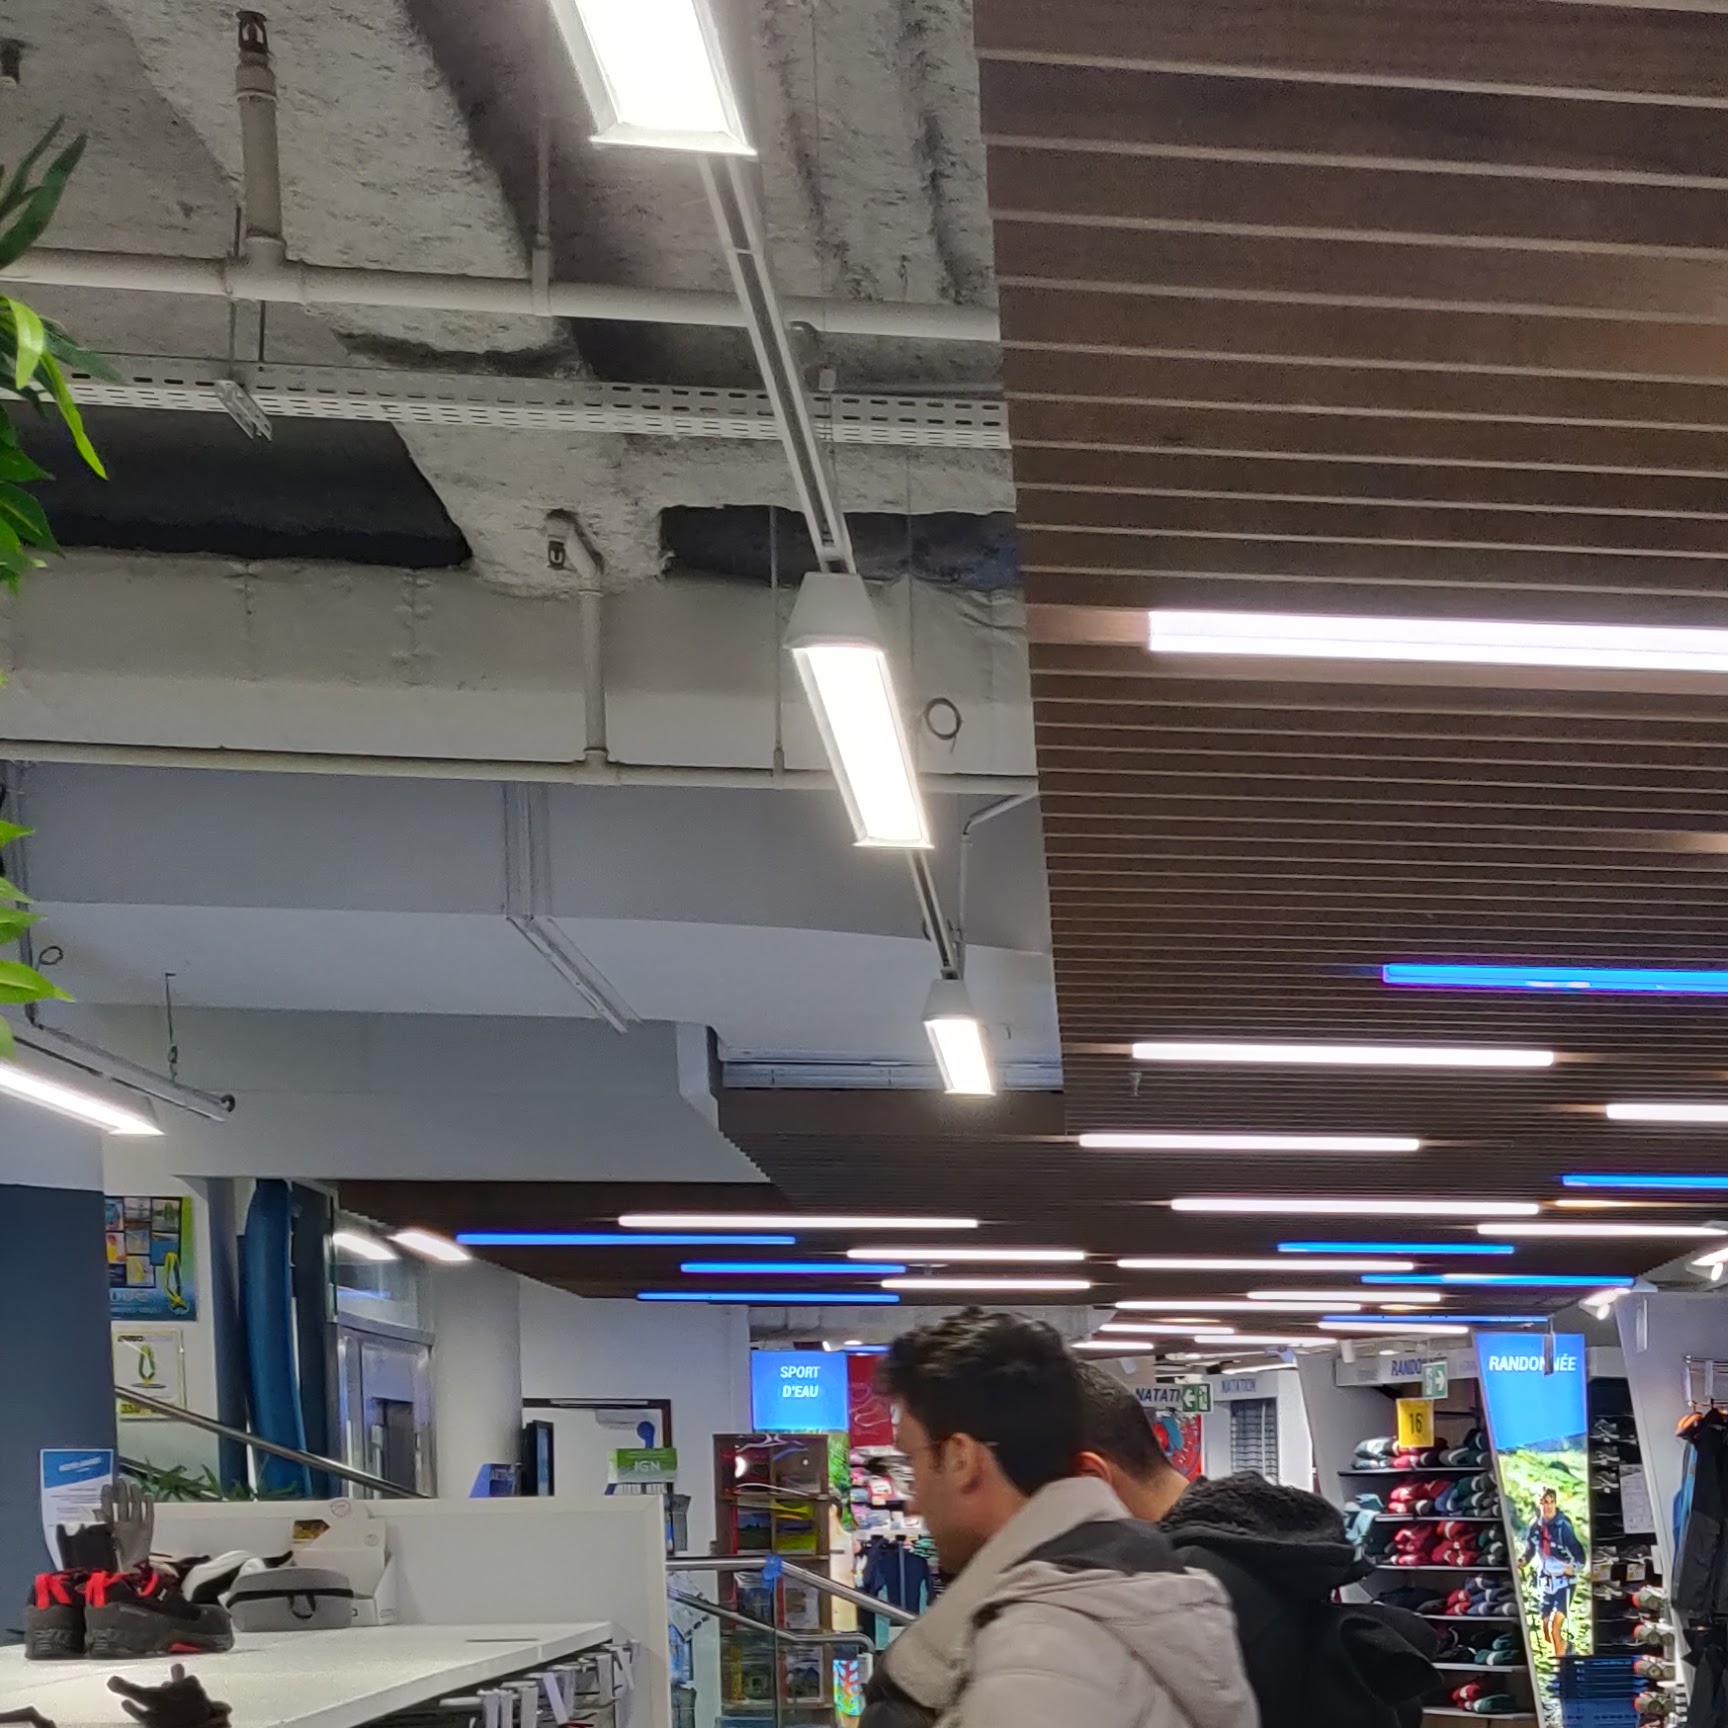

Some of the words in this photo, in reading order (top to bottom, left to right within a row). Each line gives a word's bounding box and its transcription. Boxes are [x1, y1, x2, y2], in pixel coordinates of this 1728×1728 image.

[780, 1365, 821, 1379] SPORT
[782, 1384, 819, 1398] D'EAU
[1135, 1387, 1180, 1402] NATATI
[1409, 1412, 1424, 1434] 16
[633, 1460, 661, 1472] IGN
